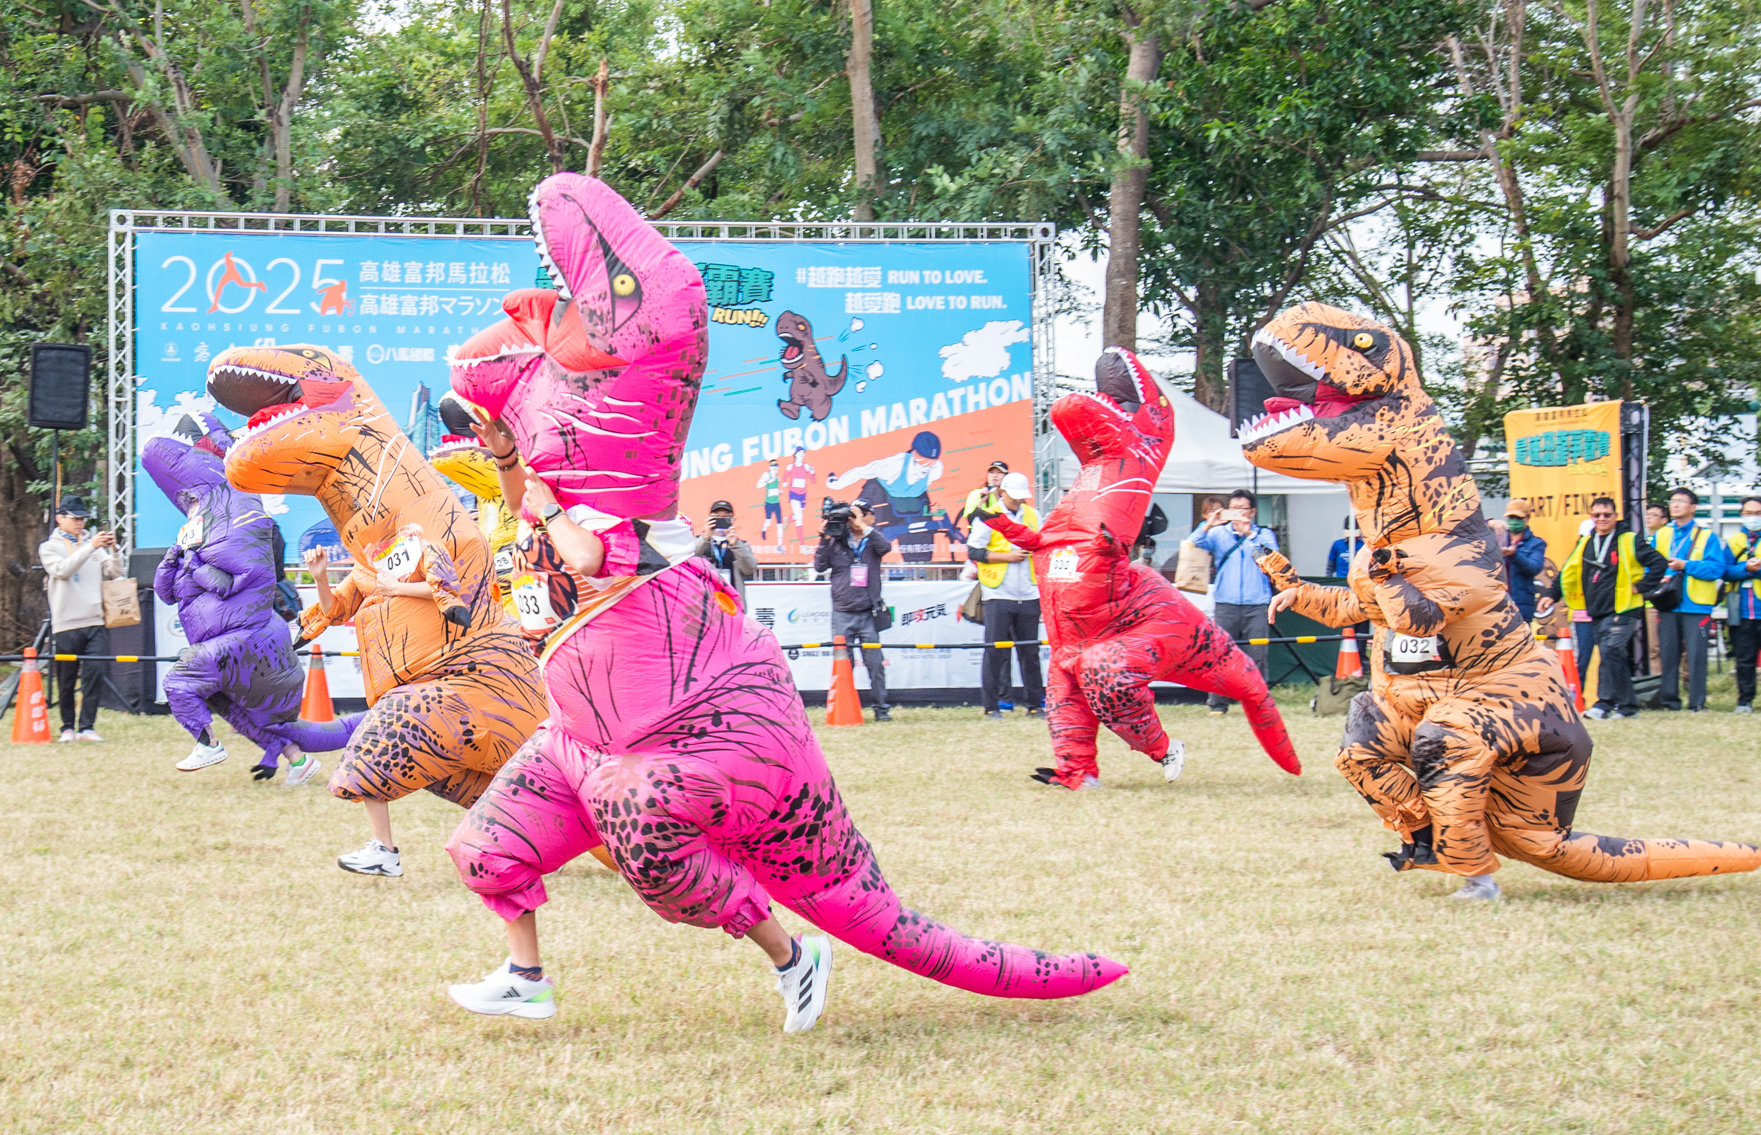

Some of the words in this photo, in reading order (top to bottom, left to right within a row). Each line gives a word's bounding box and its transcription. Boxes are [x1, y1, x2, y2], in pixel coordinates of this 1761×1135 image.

[359, 260, 511, 285] 高雄富邦馬拉松
[887, 270, 920, 284] RUN
[922, 270, 942, 284] TO
[945, 270, 988, 284] LOVE.
[160, 255, 348, 316] 2025
[694, 262, 774, 307] 霸賽
[906, 296, 945, 310] LOVE
[947, 296, 967, 310] TO
[970, 295, 1008, 309] RUN.
[160, 321, 290, 333] KAOHSIUNG
[308, 324, 378, 334] FUBON
[742, 415, 850, 466] FUBON
[860, 372, 1032, 438] MARATHON
[388, 549, 410, 570] 031
[1400, 639, 1430, 653] 032
